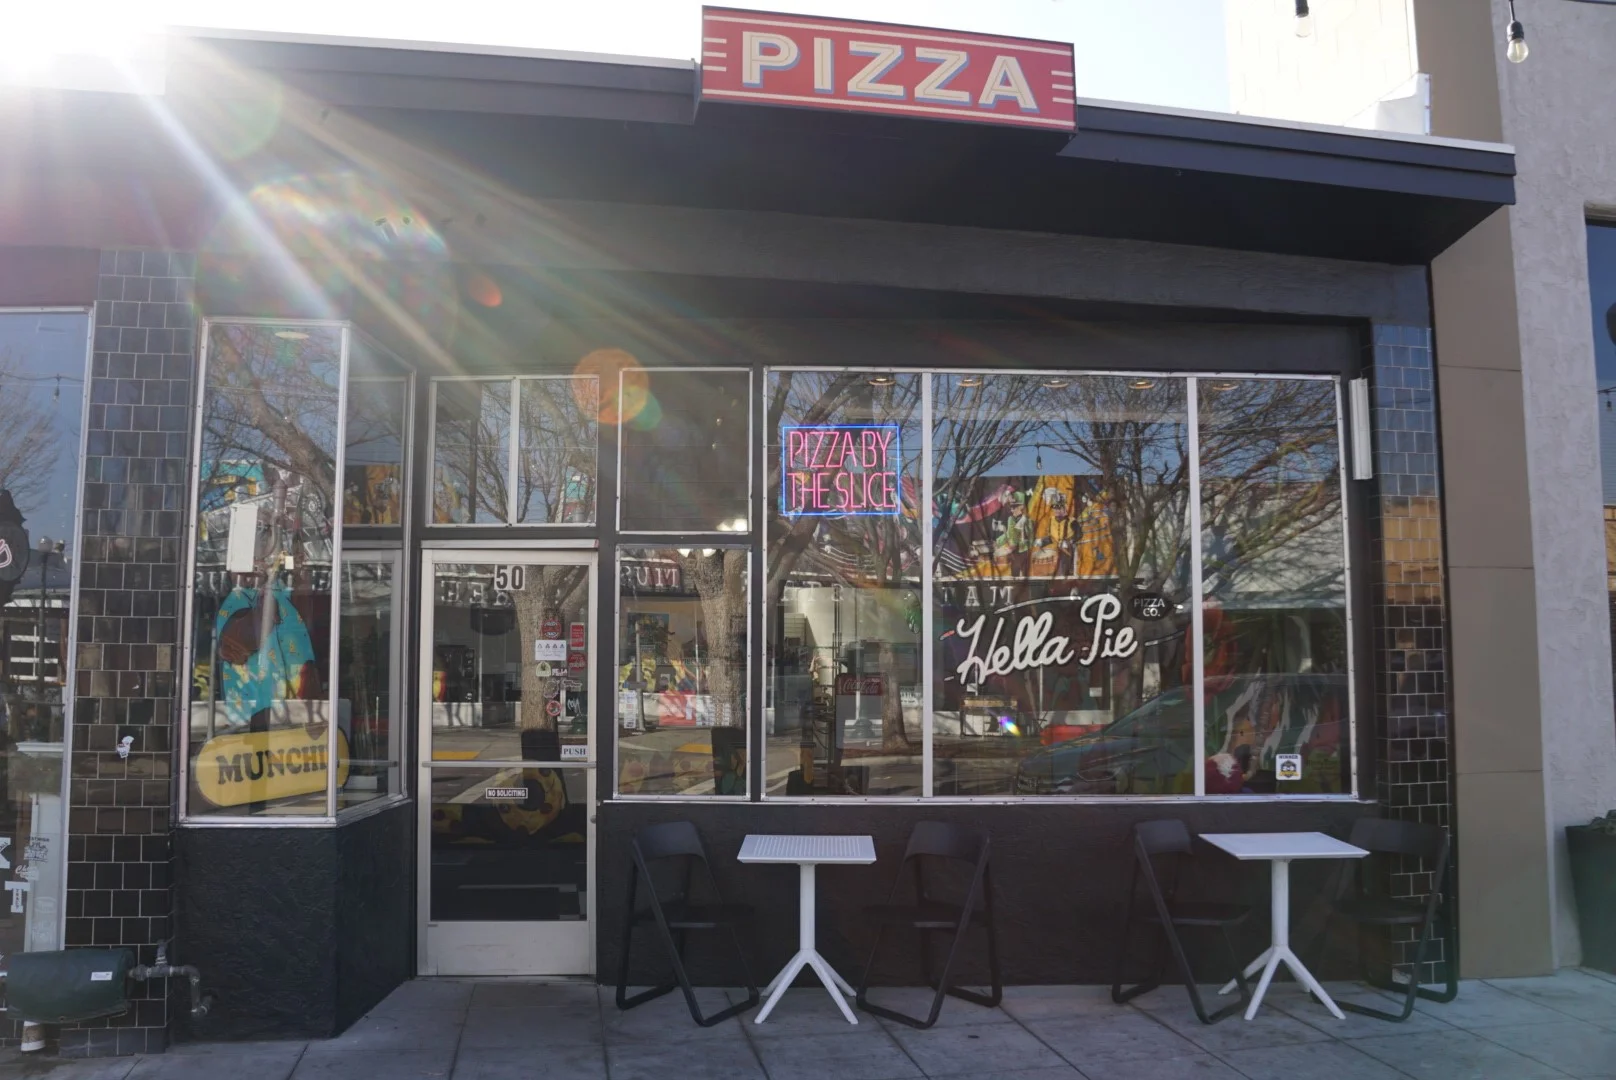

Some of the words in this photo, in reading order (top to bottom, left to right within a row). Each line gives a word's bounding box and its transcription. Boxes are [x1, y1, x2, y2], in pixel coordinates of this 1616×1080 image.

[741, 30, 1041, 114] PIZZA
[789, 431, 858, 469] PIZZA
[861, 431, 892, 469] BY
[787, 472, 830, 509] THE
[835, 472, 897, 509] SLICE
[496, 565, 523, 590] 50
[1133, 598, 1165, 608] PIZZA
[1142, 607, 1161, 618] CO.
[956, 611, 1074, 685] Hella
[1079, 593, 1139, 666] Pie
[563, 747, 586, 756] PUSH
[488, 789, 496, 797] NO
[496, 789, 526, 797] SOLICITING
